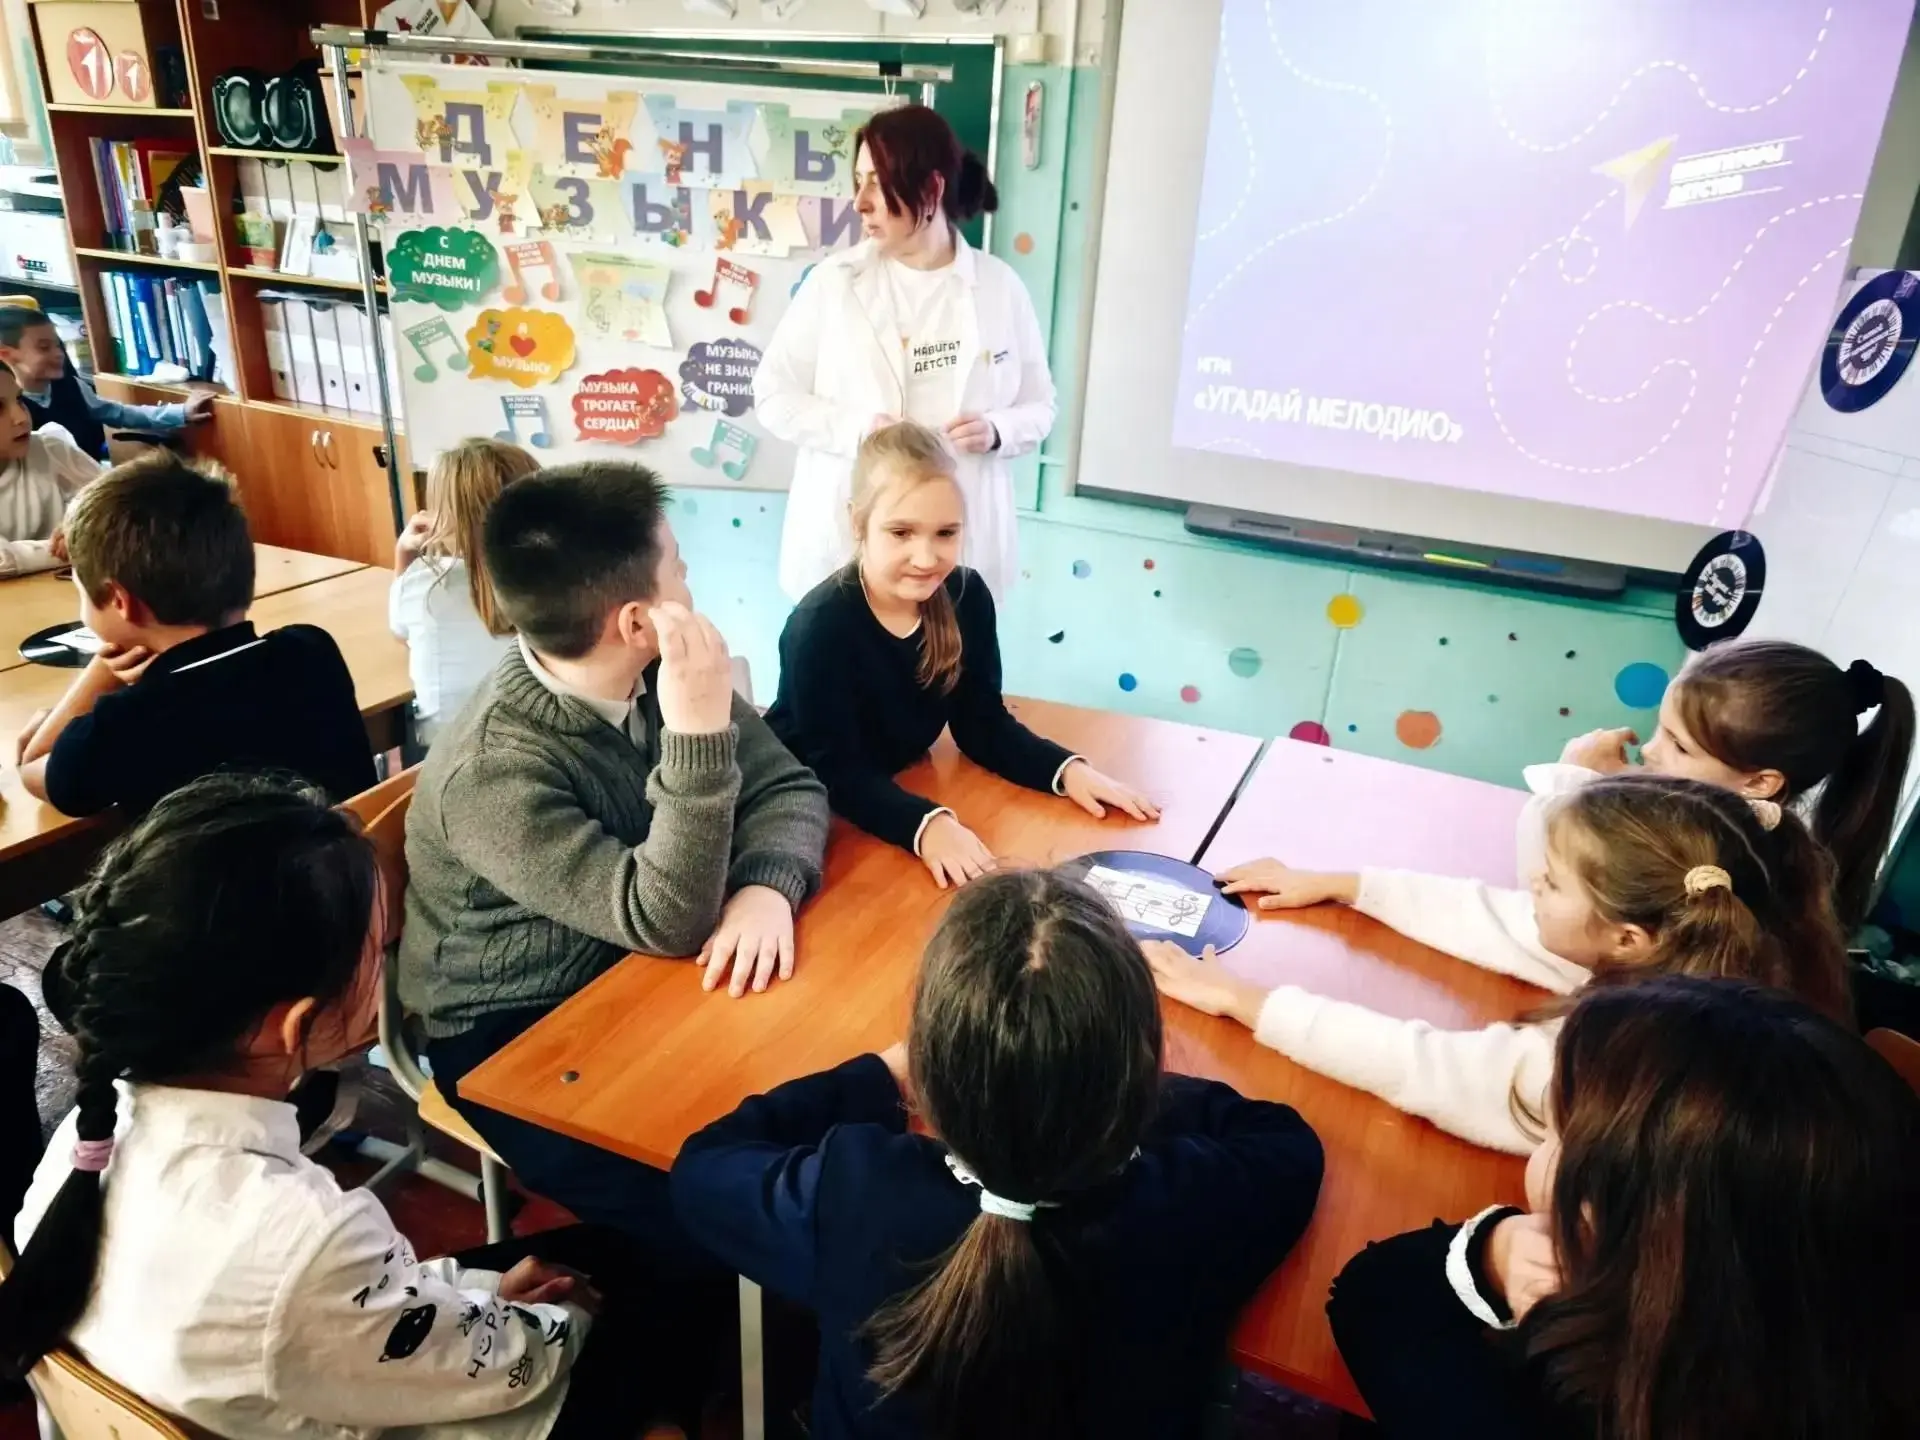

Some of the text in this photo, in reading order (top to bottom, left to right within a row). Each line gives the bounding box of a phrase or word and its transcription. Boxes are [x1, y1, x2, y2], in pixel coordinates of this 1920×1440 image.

[440, 102, 836, 182] ДЕНЬ
[377, 163, 864, 247] МУЗЫКИ
[440, 236, 448, 249] С
[424, 253, 465, 270] ДНЕМ
[706, 345, 760, 361] МУЗЫКА
[705, 363, 722, 376] НЕ
[579, 381, 640, 394] МУЗЫКА
[582, 399, 638, 412] ТРОГАЕТ
[1194, 384, 1464, 443] «УГАДАЙ МЕЛОДИЮ»
[584, 417, 640, 432] СЕРДЦА!
